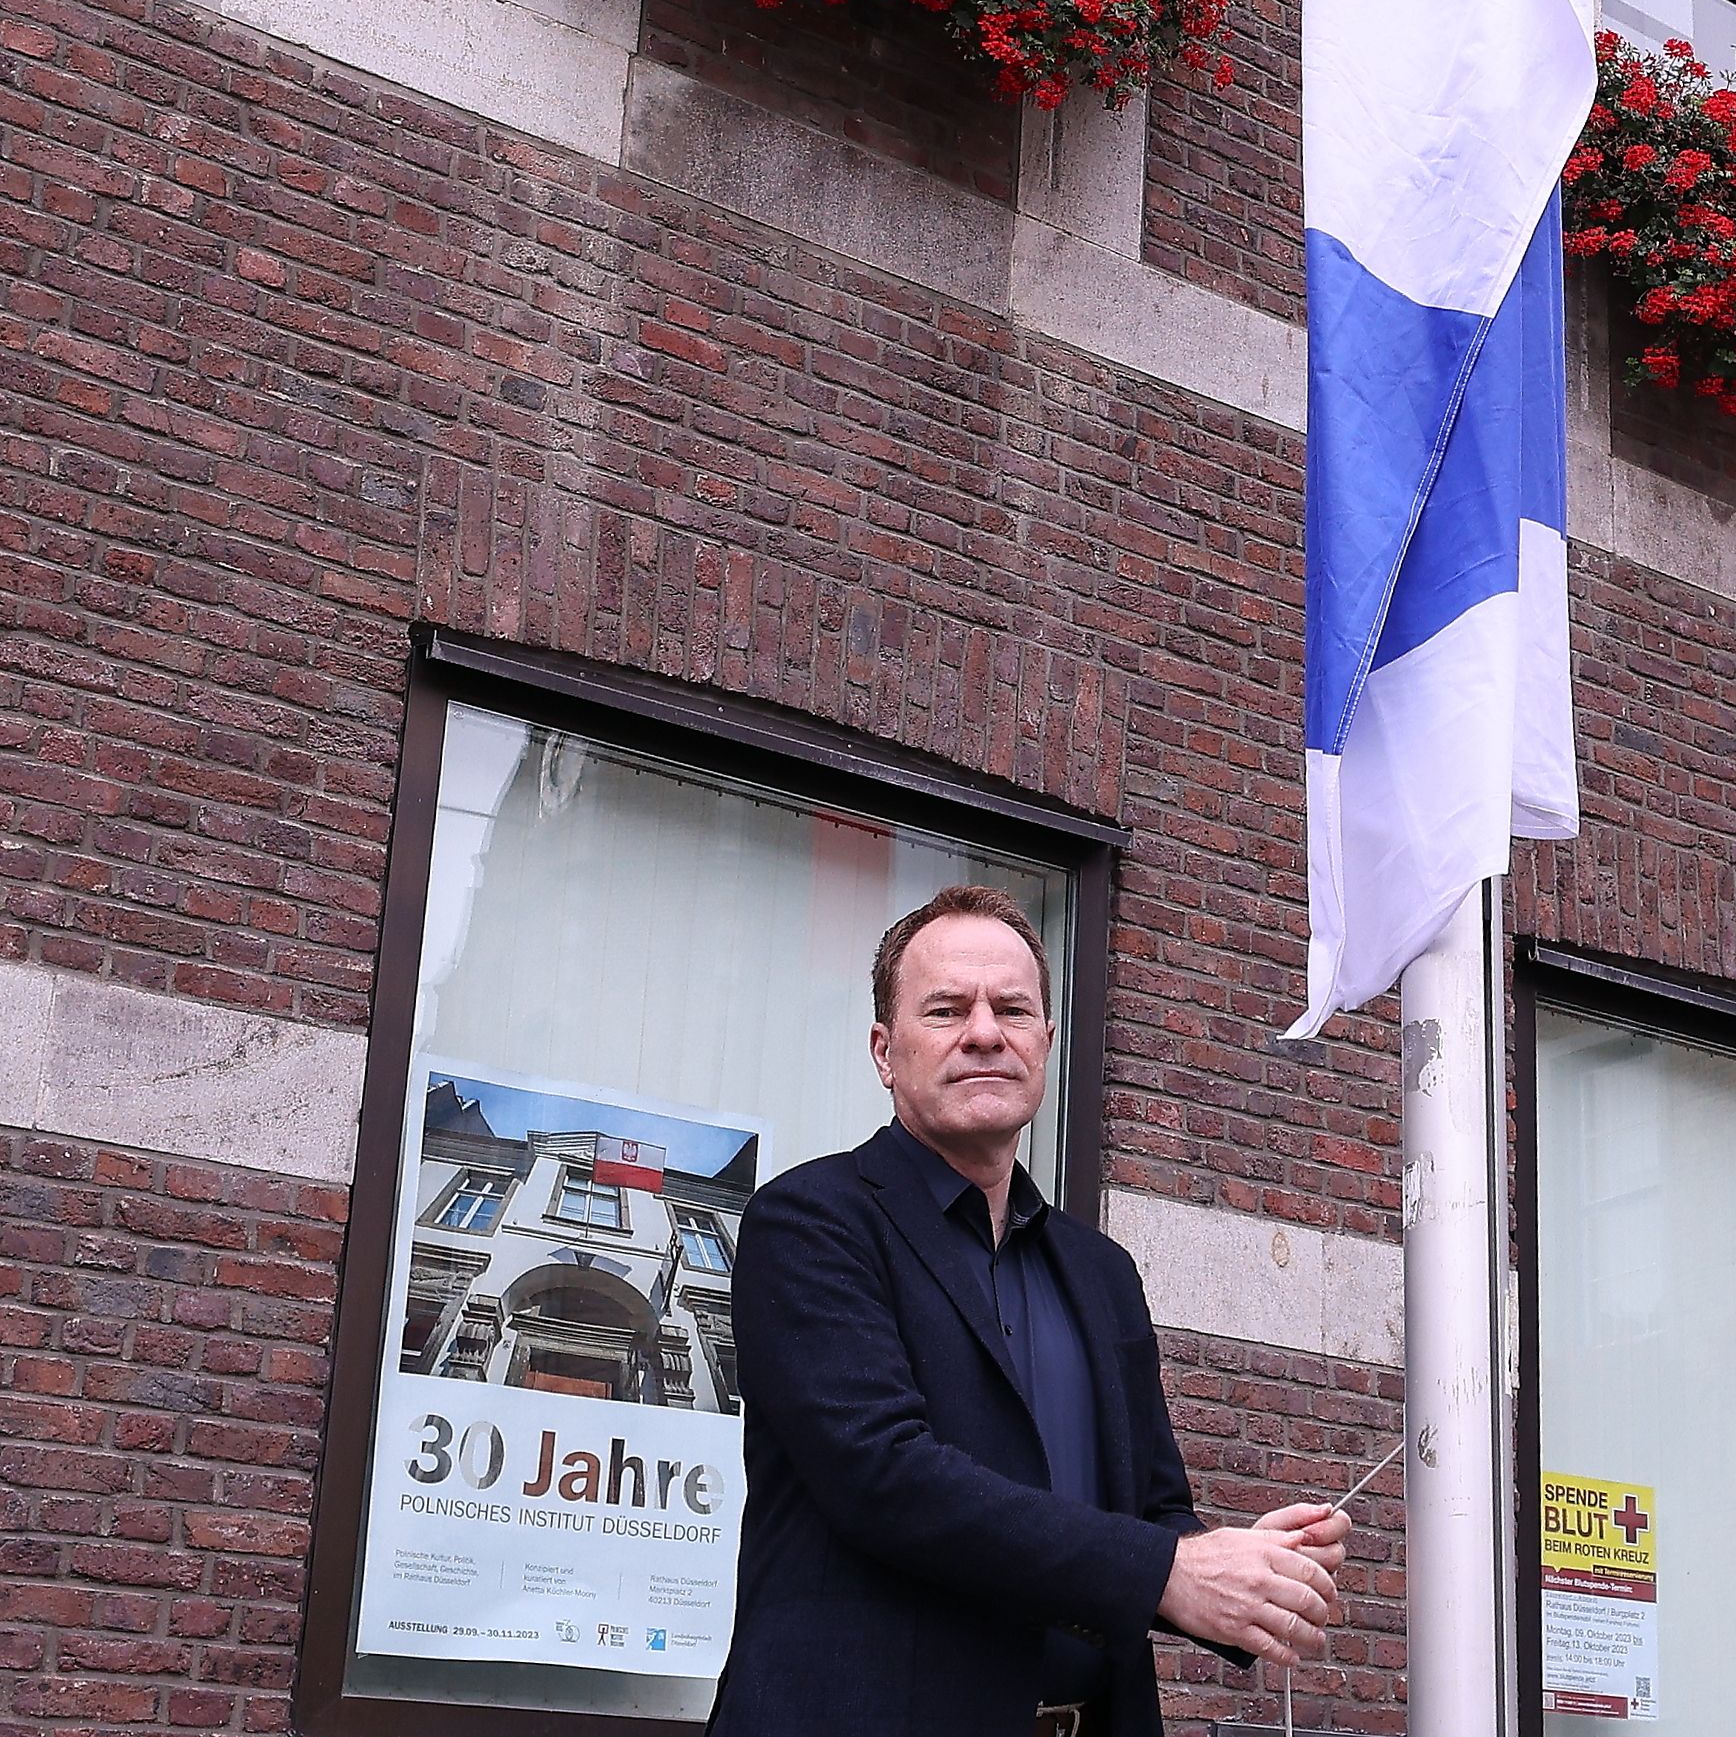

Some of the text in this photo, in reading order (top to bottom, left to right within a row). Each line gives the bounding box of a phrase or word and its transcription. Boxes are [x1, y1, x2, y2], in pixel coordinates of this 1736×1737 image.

[403, 1413, 725, 1515] 30 Jahre
[1544, 1483, 1608, 1509] SPENDE
[400, 1493, 723, 1545] POLNISCHES INSTITUT DÜSSELDORF
[1544, 1506, 1609, 1540] BLUT
[1544, 1538, 1649, 1564] BEIM ROTEN KREUZ
[1544, 1574, 1573, 1586] Nächster
[648, 1596, 672, 1604] 40213
[1546, 1600, 1572, 1612] Rathaus
[1573, 1603, 1606, 1616] Düsseldorf
[388, 1620, 448, 1634] AUSSTELLUNG
[1587, 1629, 1612, 1640] Oktober
[1614, 1632, 1632, 1643] 2023
[1584, 1642, 1610, 1652] Oktober
[1612, 1644, 1628, 1654] 2023
